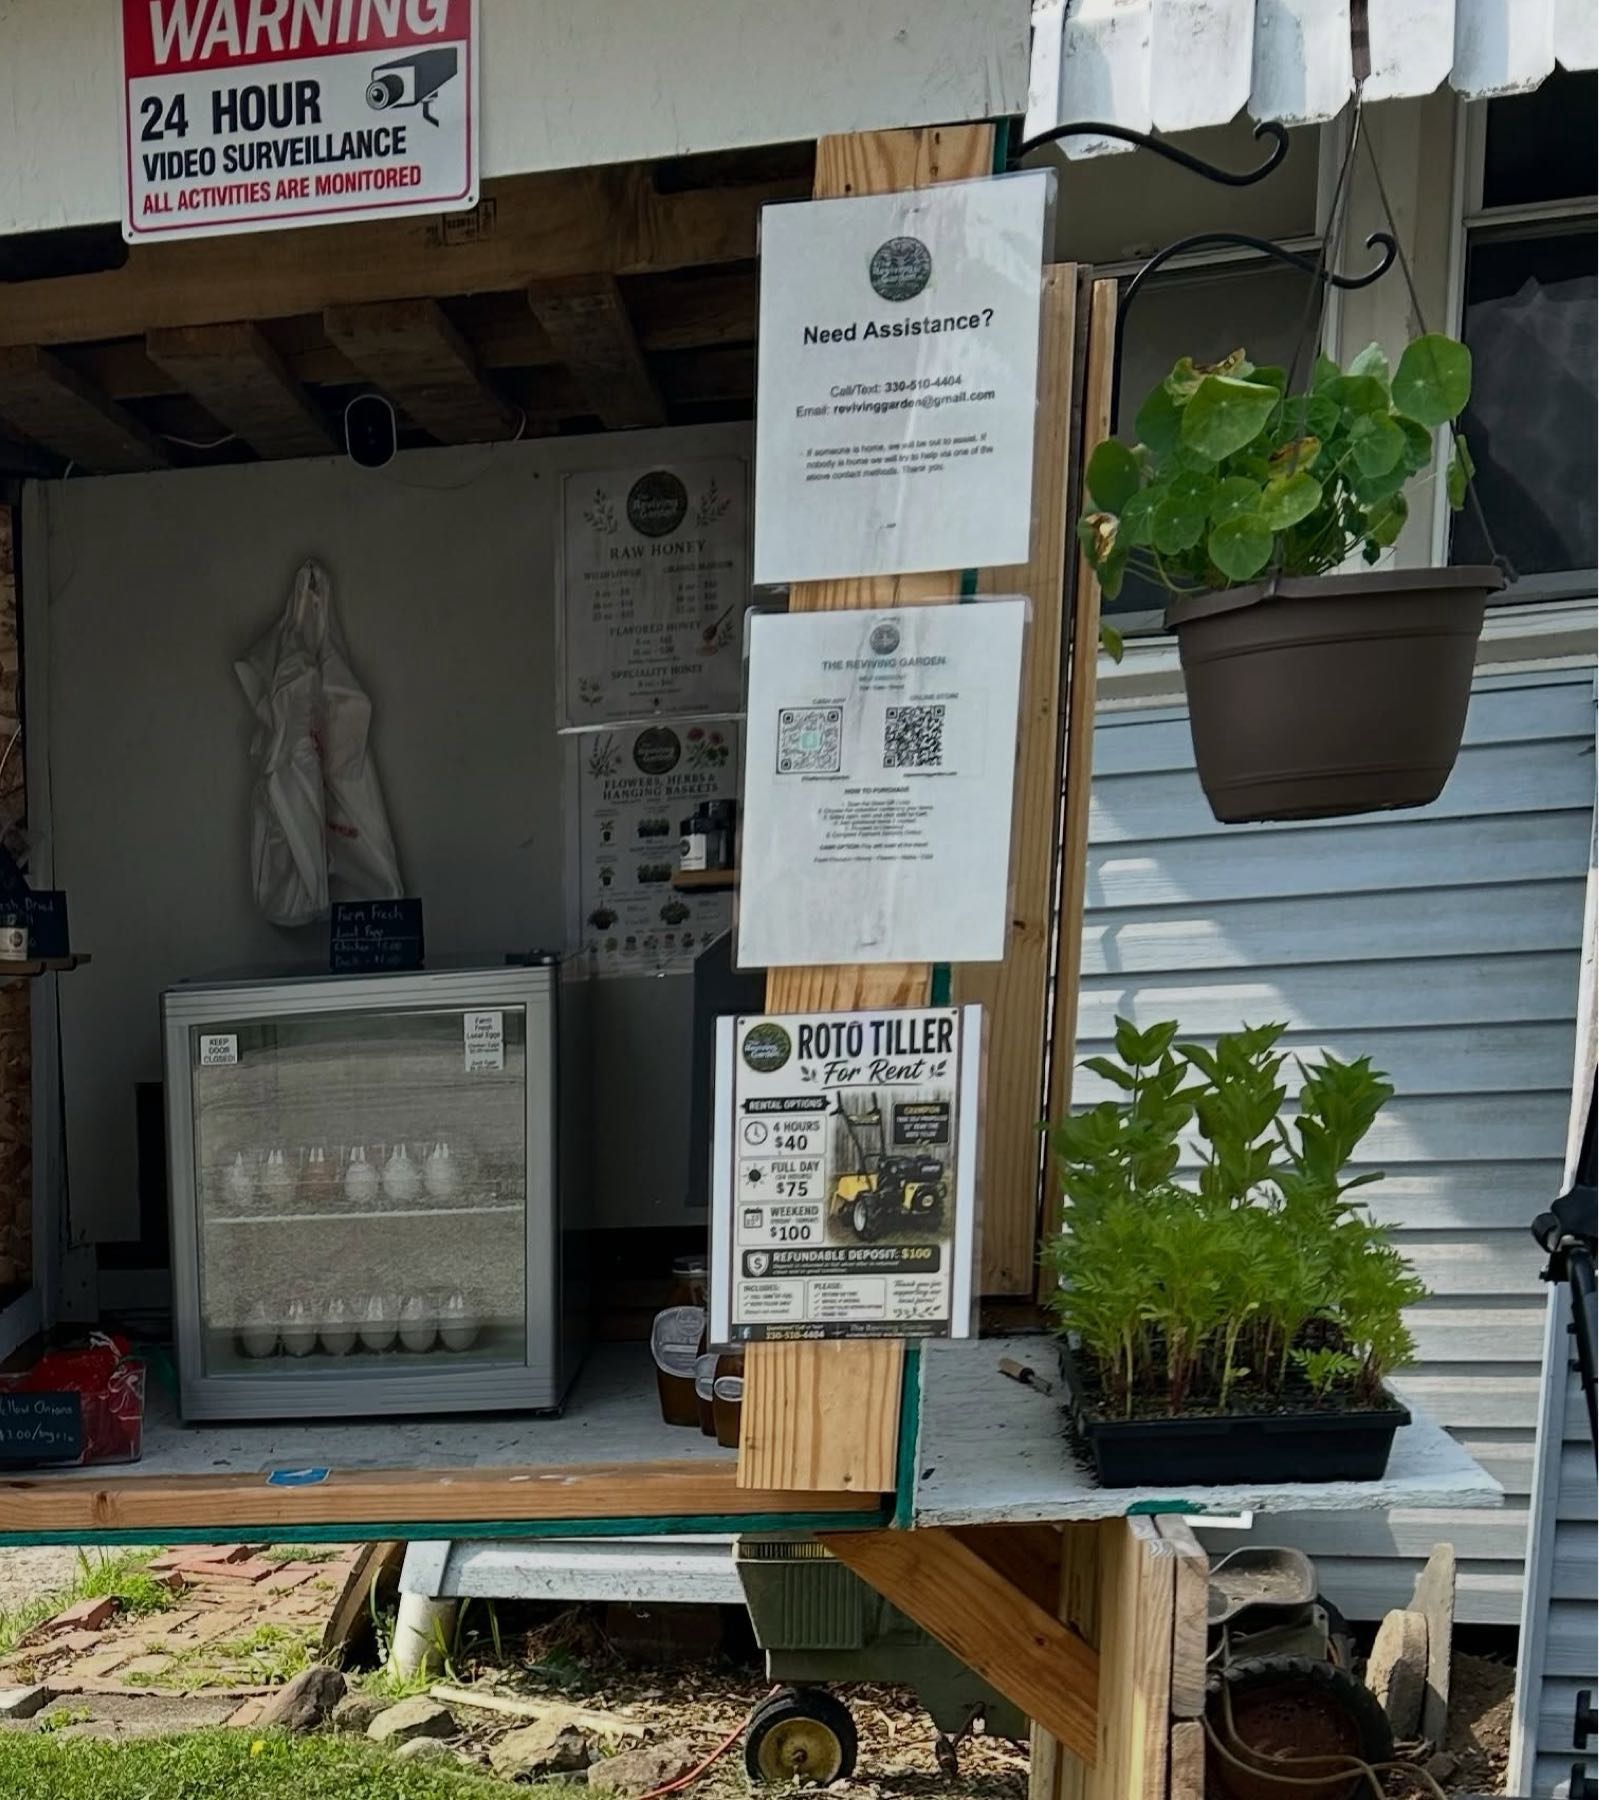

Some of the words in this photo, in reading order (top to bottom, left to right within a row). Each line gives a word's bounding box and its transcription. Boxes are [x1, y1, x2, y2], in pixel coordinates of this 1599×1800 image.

[149, 0, 449, 65] WARNING
[140, 93, 189, 142] 24
[212, 80, 322, 135] HOUR
[143, 146, 216, 182] VIDEO
[223, 126, 407, 174] SURVEILLANCE
[143, 191, 173, 215] ALL
[177, 181, 270, 211] ACTIVITIES
[275, 177, 310, 200] ARE
[315, 165, 421, 195] MONITORED
[803, 323, 857, 345] Need
[863, 308, 994, 340] Assistance?
[830, 384, 881, 398] Call/Text:
[885, 374, 962, 392] 330-510-4404
[796, 405, 830, 418] Email:
[833, 389, 995, 414] revivinggarden@gmail.com
[609, 545, 645, 561] RAW
[651, 539, 707, 556] HONEY
[610, 622, 663, 637] FLAVORED
[821, 660, 843, 671] THE
[846, 658, 896, 670] REVIVING
[899, 656, 946, 668] GARDEN
[603, 786, 662, 800] HANGING
[665, 782, 719, 796] BASKETS
[371, 904, 404, 920] Fresh
[797, 1022, 863, 1060] ROTO
[870, 1018, 953, 1056] TILLER
[823, 1059, 862, 1085] For
[868, 1058, 927, 1084] Rent
[748, 1100, 783, 1111] RENTAL
[784, 1099, 823, 1109] OPTIONS
[773, 1122, 780, 1132] 4
[783, 1120, 820, 1132] HOURS
[775, 1135, 808, 1151] $40
[771, 1162, 796, 1173] FULL
[800, 1160, 821, 1172] DAY
[776, 1181, 808, 1197] $75
[770, 1206, 819, 1217] WEEKEND
[770, 1225, 811, 1241] $100
[773, 1250, 846, 1262] REFUNDABLE
[848, 1248, 899, 1261] DEPOSIT:
[901, 1247, 932, 1259] $100
[34, 1400, 73, 1415] Onions
